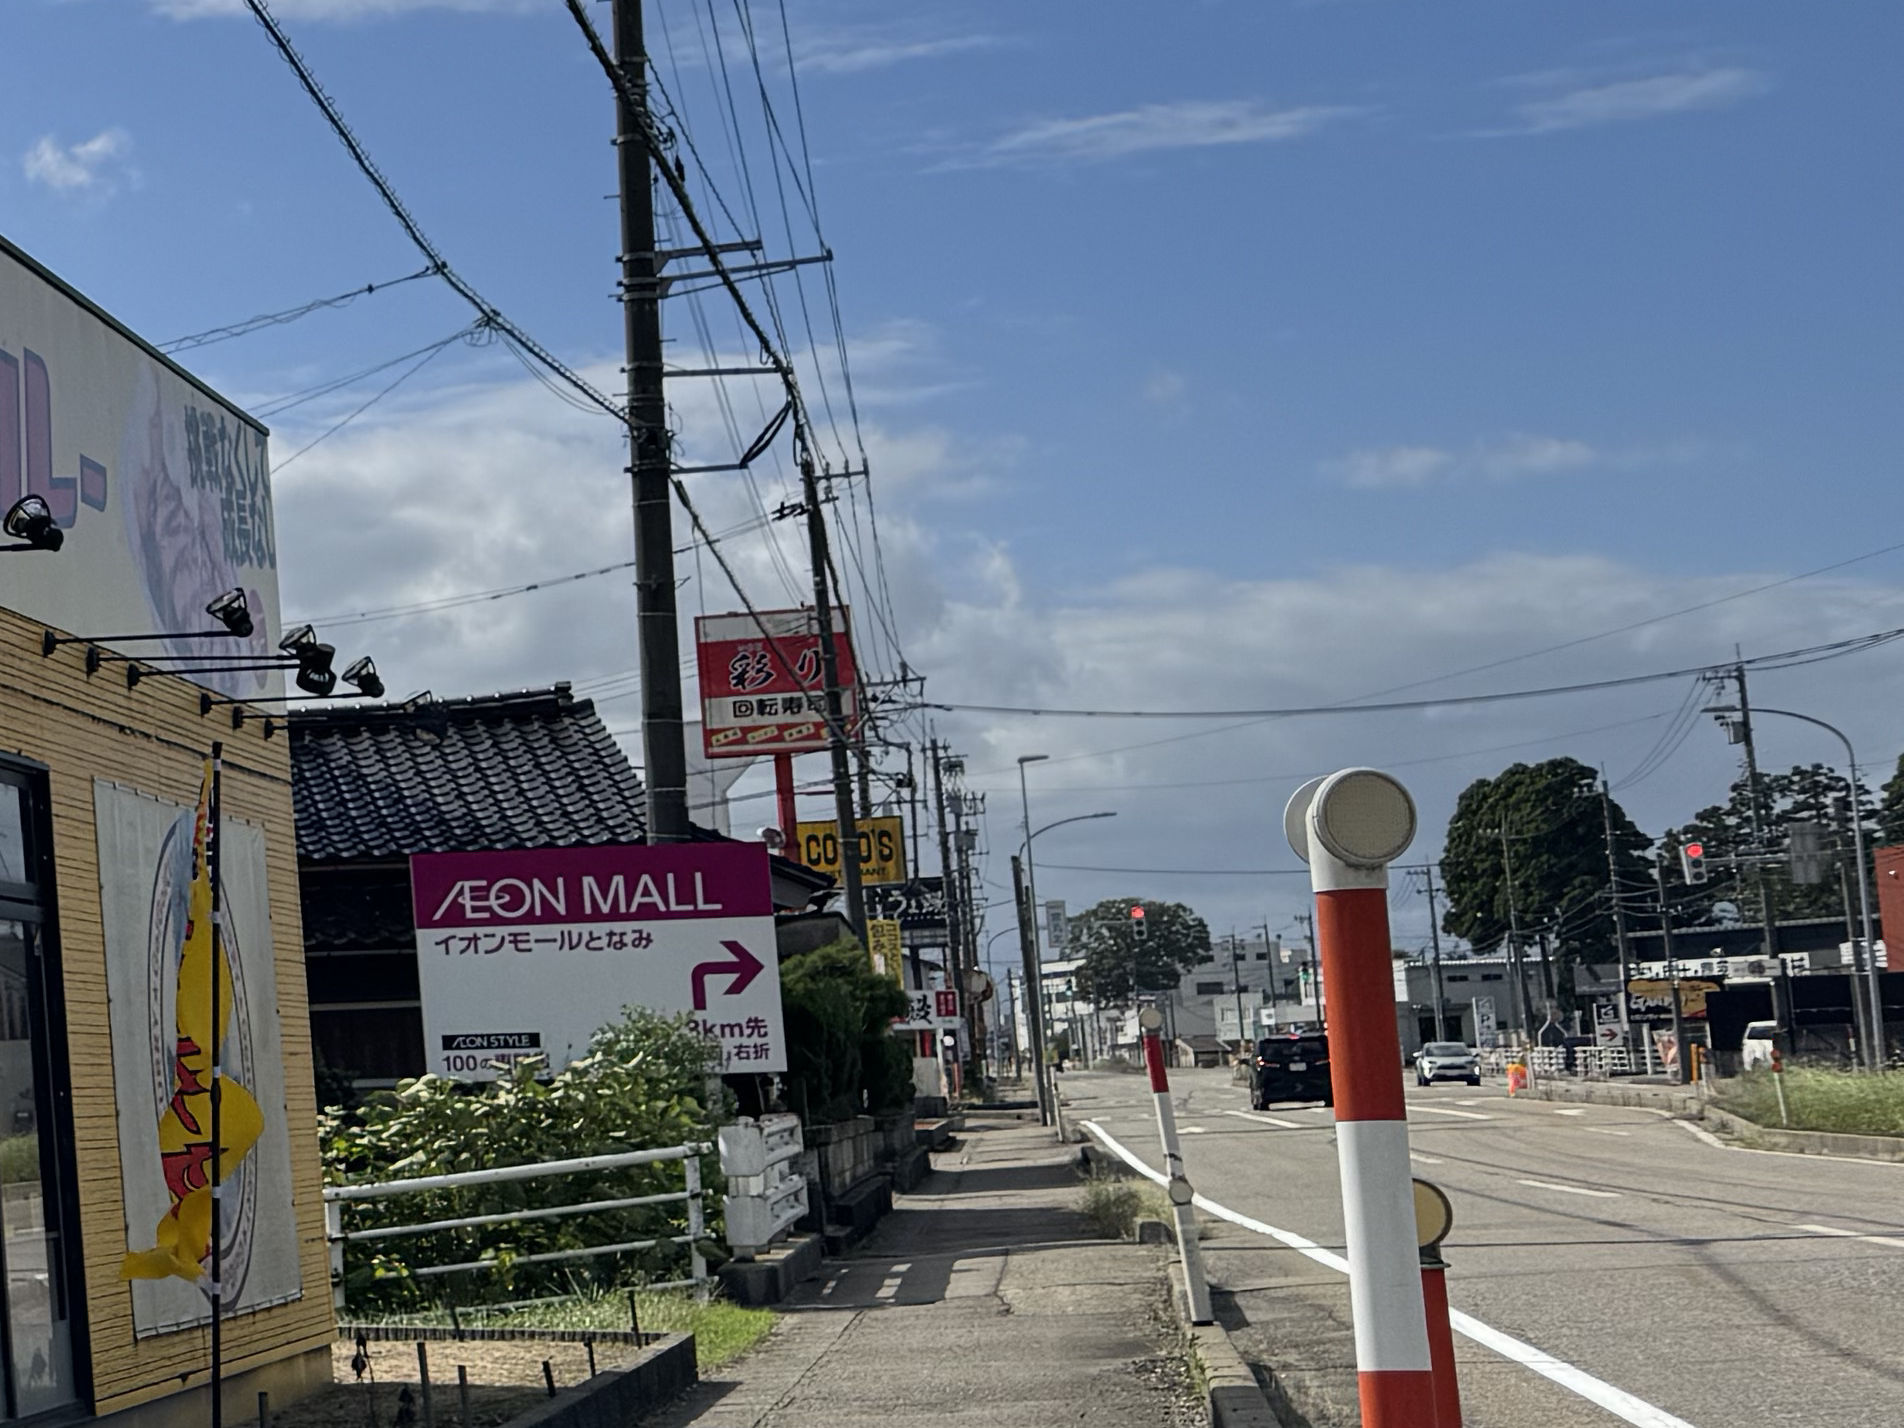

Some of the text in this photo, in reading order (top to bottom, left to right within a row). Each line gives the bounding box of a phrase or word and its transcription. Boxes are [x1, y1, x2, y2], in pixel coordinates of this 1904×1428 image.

[806, 828, 894, 866] COO'S
[581, 871, 723, 915] MALL
[434, 928, 654, 956] イオンモールとなみ
[490, 1034, 531, 1048] STYLE
